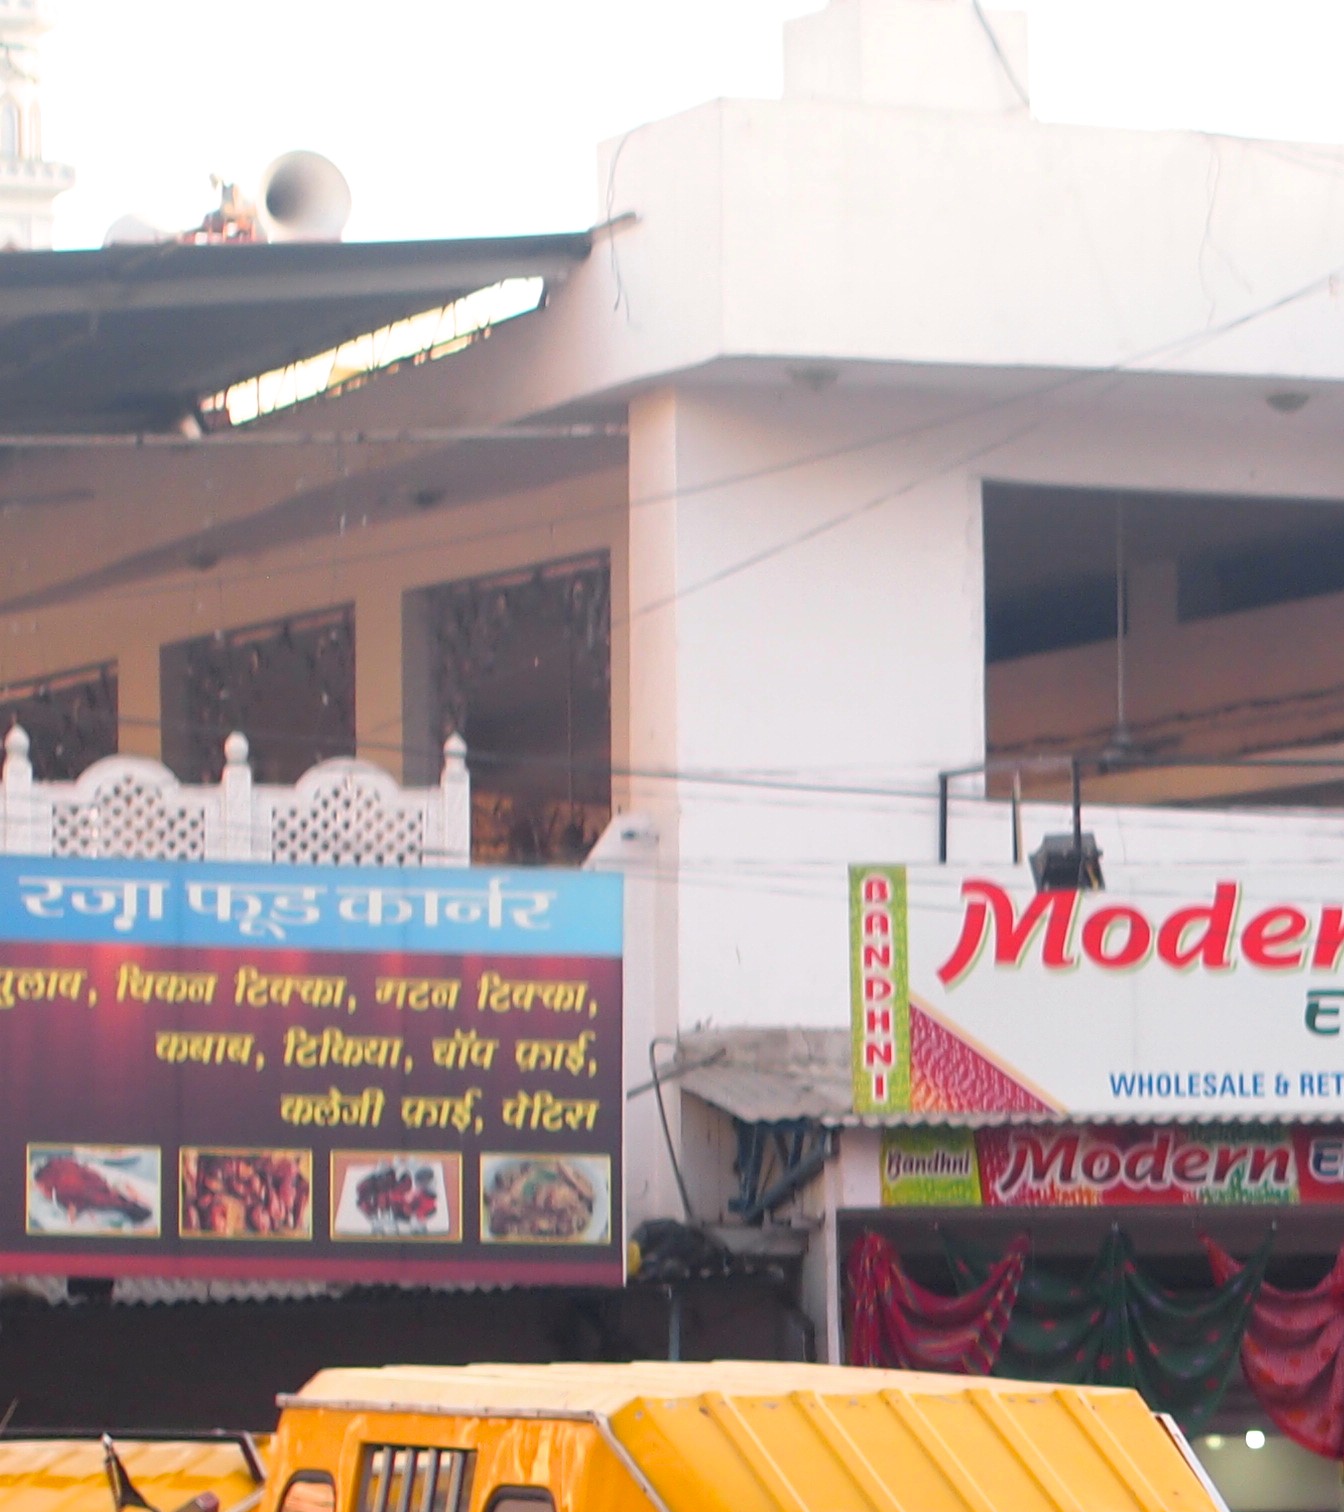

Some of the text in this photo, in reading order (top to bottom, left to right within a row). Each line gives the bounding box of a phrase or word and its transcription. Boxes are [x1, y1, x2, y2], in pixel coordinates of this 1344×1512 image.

[185, 879, 327, 940] फूड
[863, 876, 893, 1099] BANDHNI
[1109, 1072, 1265, 1098] WHOLESALE
[1274, 1072, 1290, 1098] &
[999, 1129, 1294, 1193] Modern
